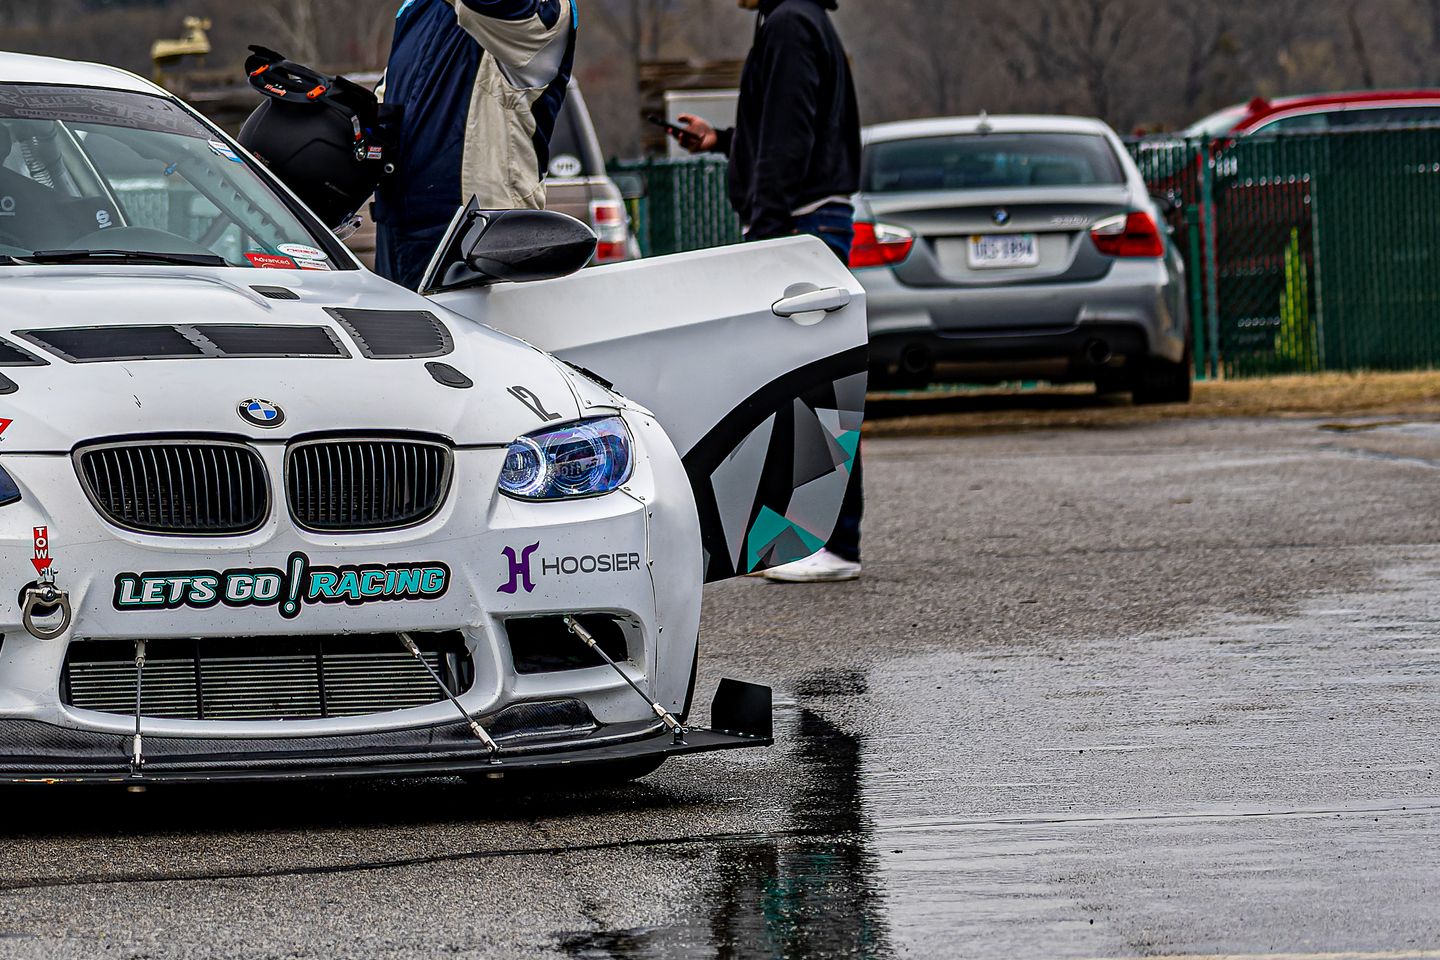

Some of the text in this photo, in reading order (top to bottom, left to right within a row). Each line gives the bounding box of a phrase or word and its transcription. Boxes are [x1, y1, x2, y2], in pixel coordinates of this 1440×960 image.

[253, 256, 291, 266] Advanced
[506, 385, 563, 422] 12
[36, 527, 48, 560] TOW
[542, 552, 641, 576] HOOSIER
[119, 576, 219, 605] LETS
[310, 567, 445, 599] RACING
